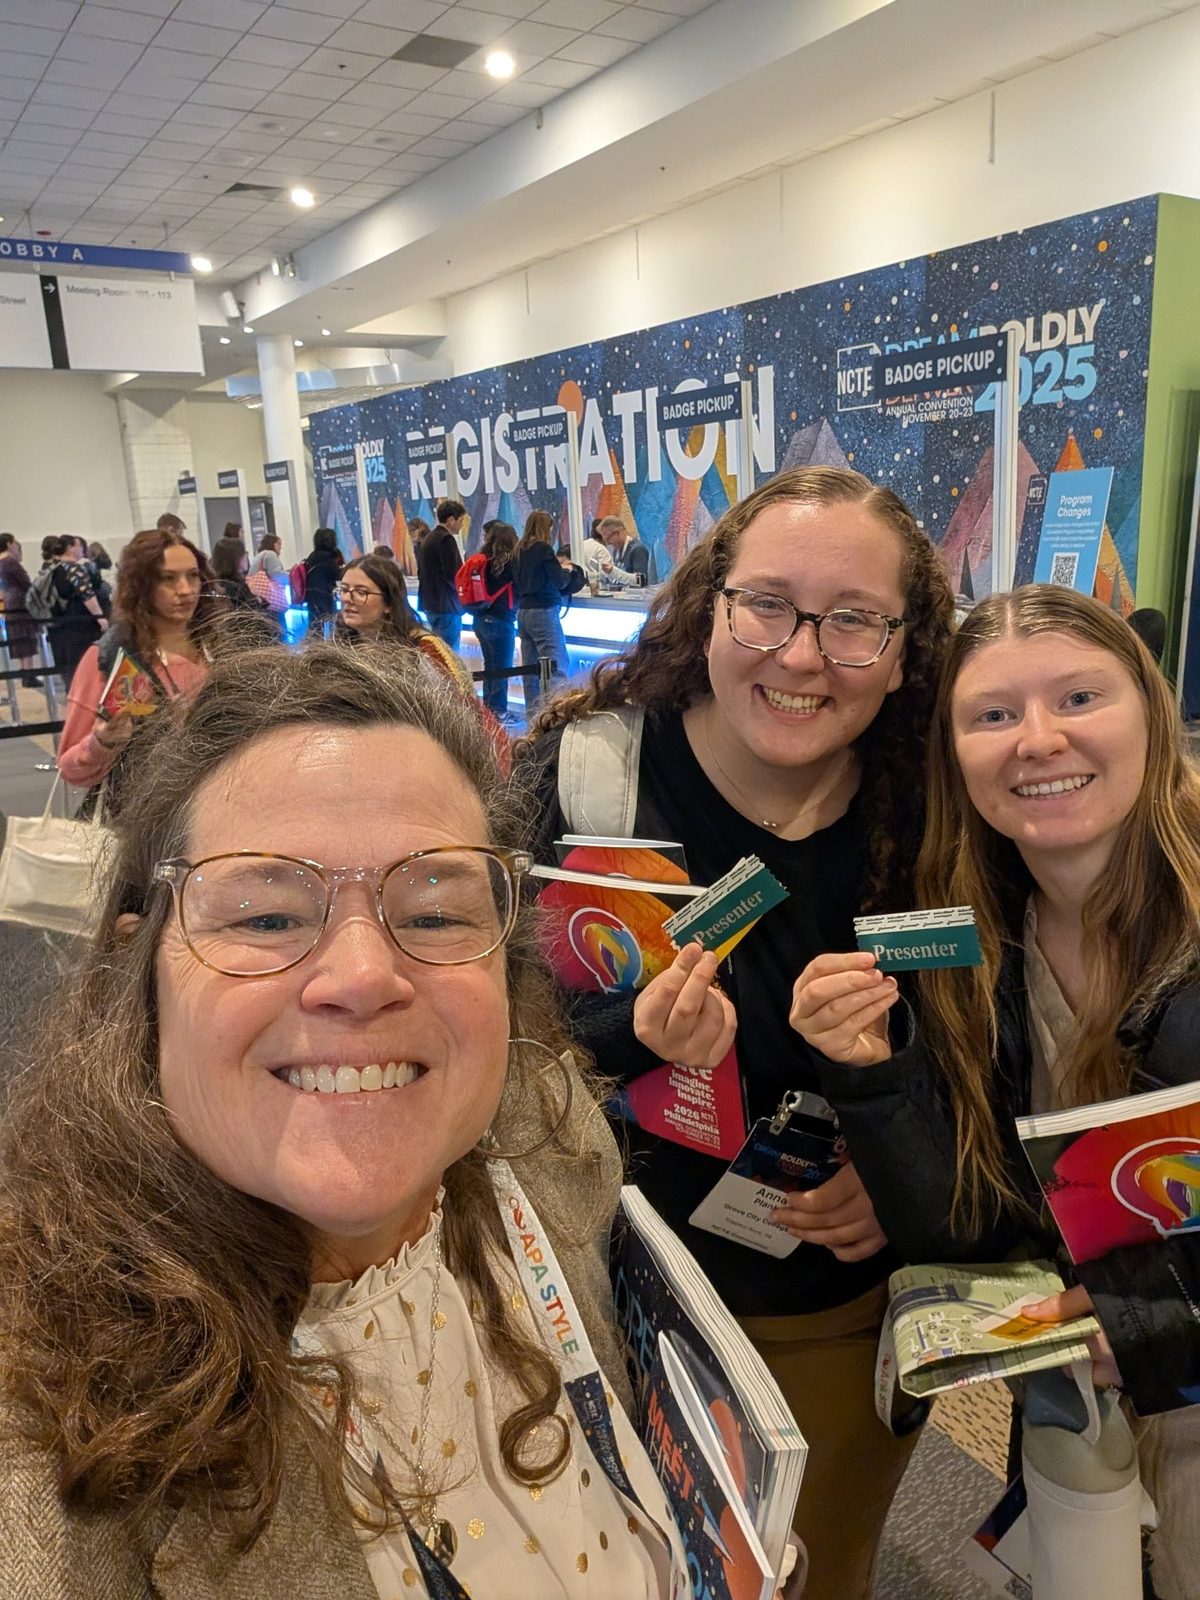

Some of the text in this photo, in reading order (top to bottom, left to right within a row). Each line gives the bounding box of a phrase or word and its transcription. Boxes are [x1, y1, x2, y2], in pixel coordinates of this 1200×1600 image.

[72, 248, 84, 261] A
[66, 284, 101, 297] Meeting
[979, 304, 1102, 353] OLDLY
[884, 349, 995, 386] BADGE PICKUP
[837, 366, 875, 395] NCTE
[663, 394, 735, 421] BADGE PICKUP
[885, 396, 974, 417] ANNUAL CONVENTION
[902, 407, 974, 424] NOVEMBER 20-23
[513, 422, 564, 442] BADGE PICKUP
[357, 438, 385, 459] OLDLY
[408, 443, 444, 458] BADGE PICKUP
[1060, 494, 1093, 507] Program
[1057, 507, 1092, 520] Changes
[691, 888, 764, 947] Presenter
[872, 940, 959, 962] Presenter
[663, 1108, 720, 1135] Philadelphia
[673, 1103, 700, 1120] 2026
[755, 1187, 788, 1205] Anna
[746, 1212, 761, 1222] City
[519, 1231, 580, 1357] APA STYLE
